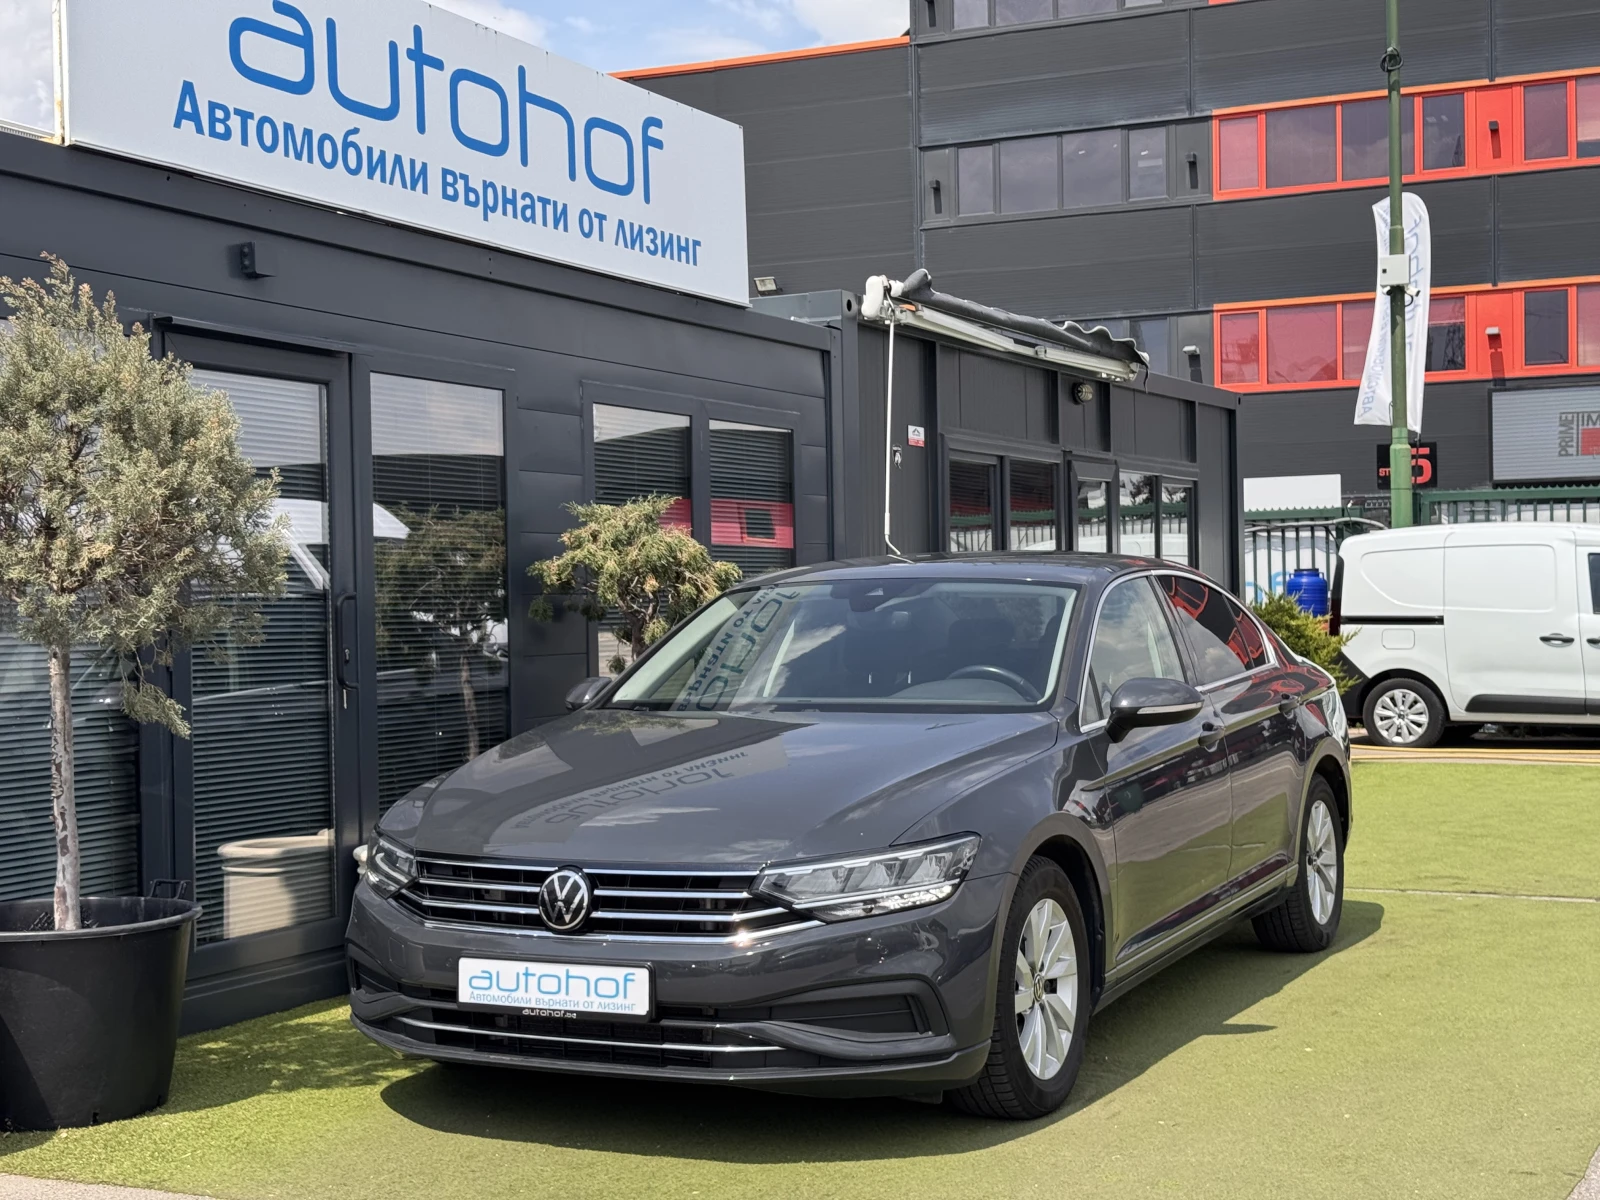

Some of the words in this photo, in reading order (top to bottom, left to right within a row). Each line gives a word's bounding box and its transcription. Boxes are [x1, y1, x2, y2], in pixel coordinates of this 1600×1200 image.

[229, 0, 663, 204] autohof
[172, 80, 429, 197] Автомобили
[441, 166, 569, 233] върнати
[577, 208, 607, 244] от
[614, 222, 702, 267] лизинг
[1558, 414, 1575, 457] PRIME
[468, 966, 636, 999] autohof
[469, 990, 532, 1006] Автомобили
[535, 997, 580, 1009] върнати
[583, 1001, 594, 1010] от
[597, 1001, 636, 1012] лизинг
